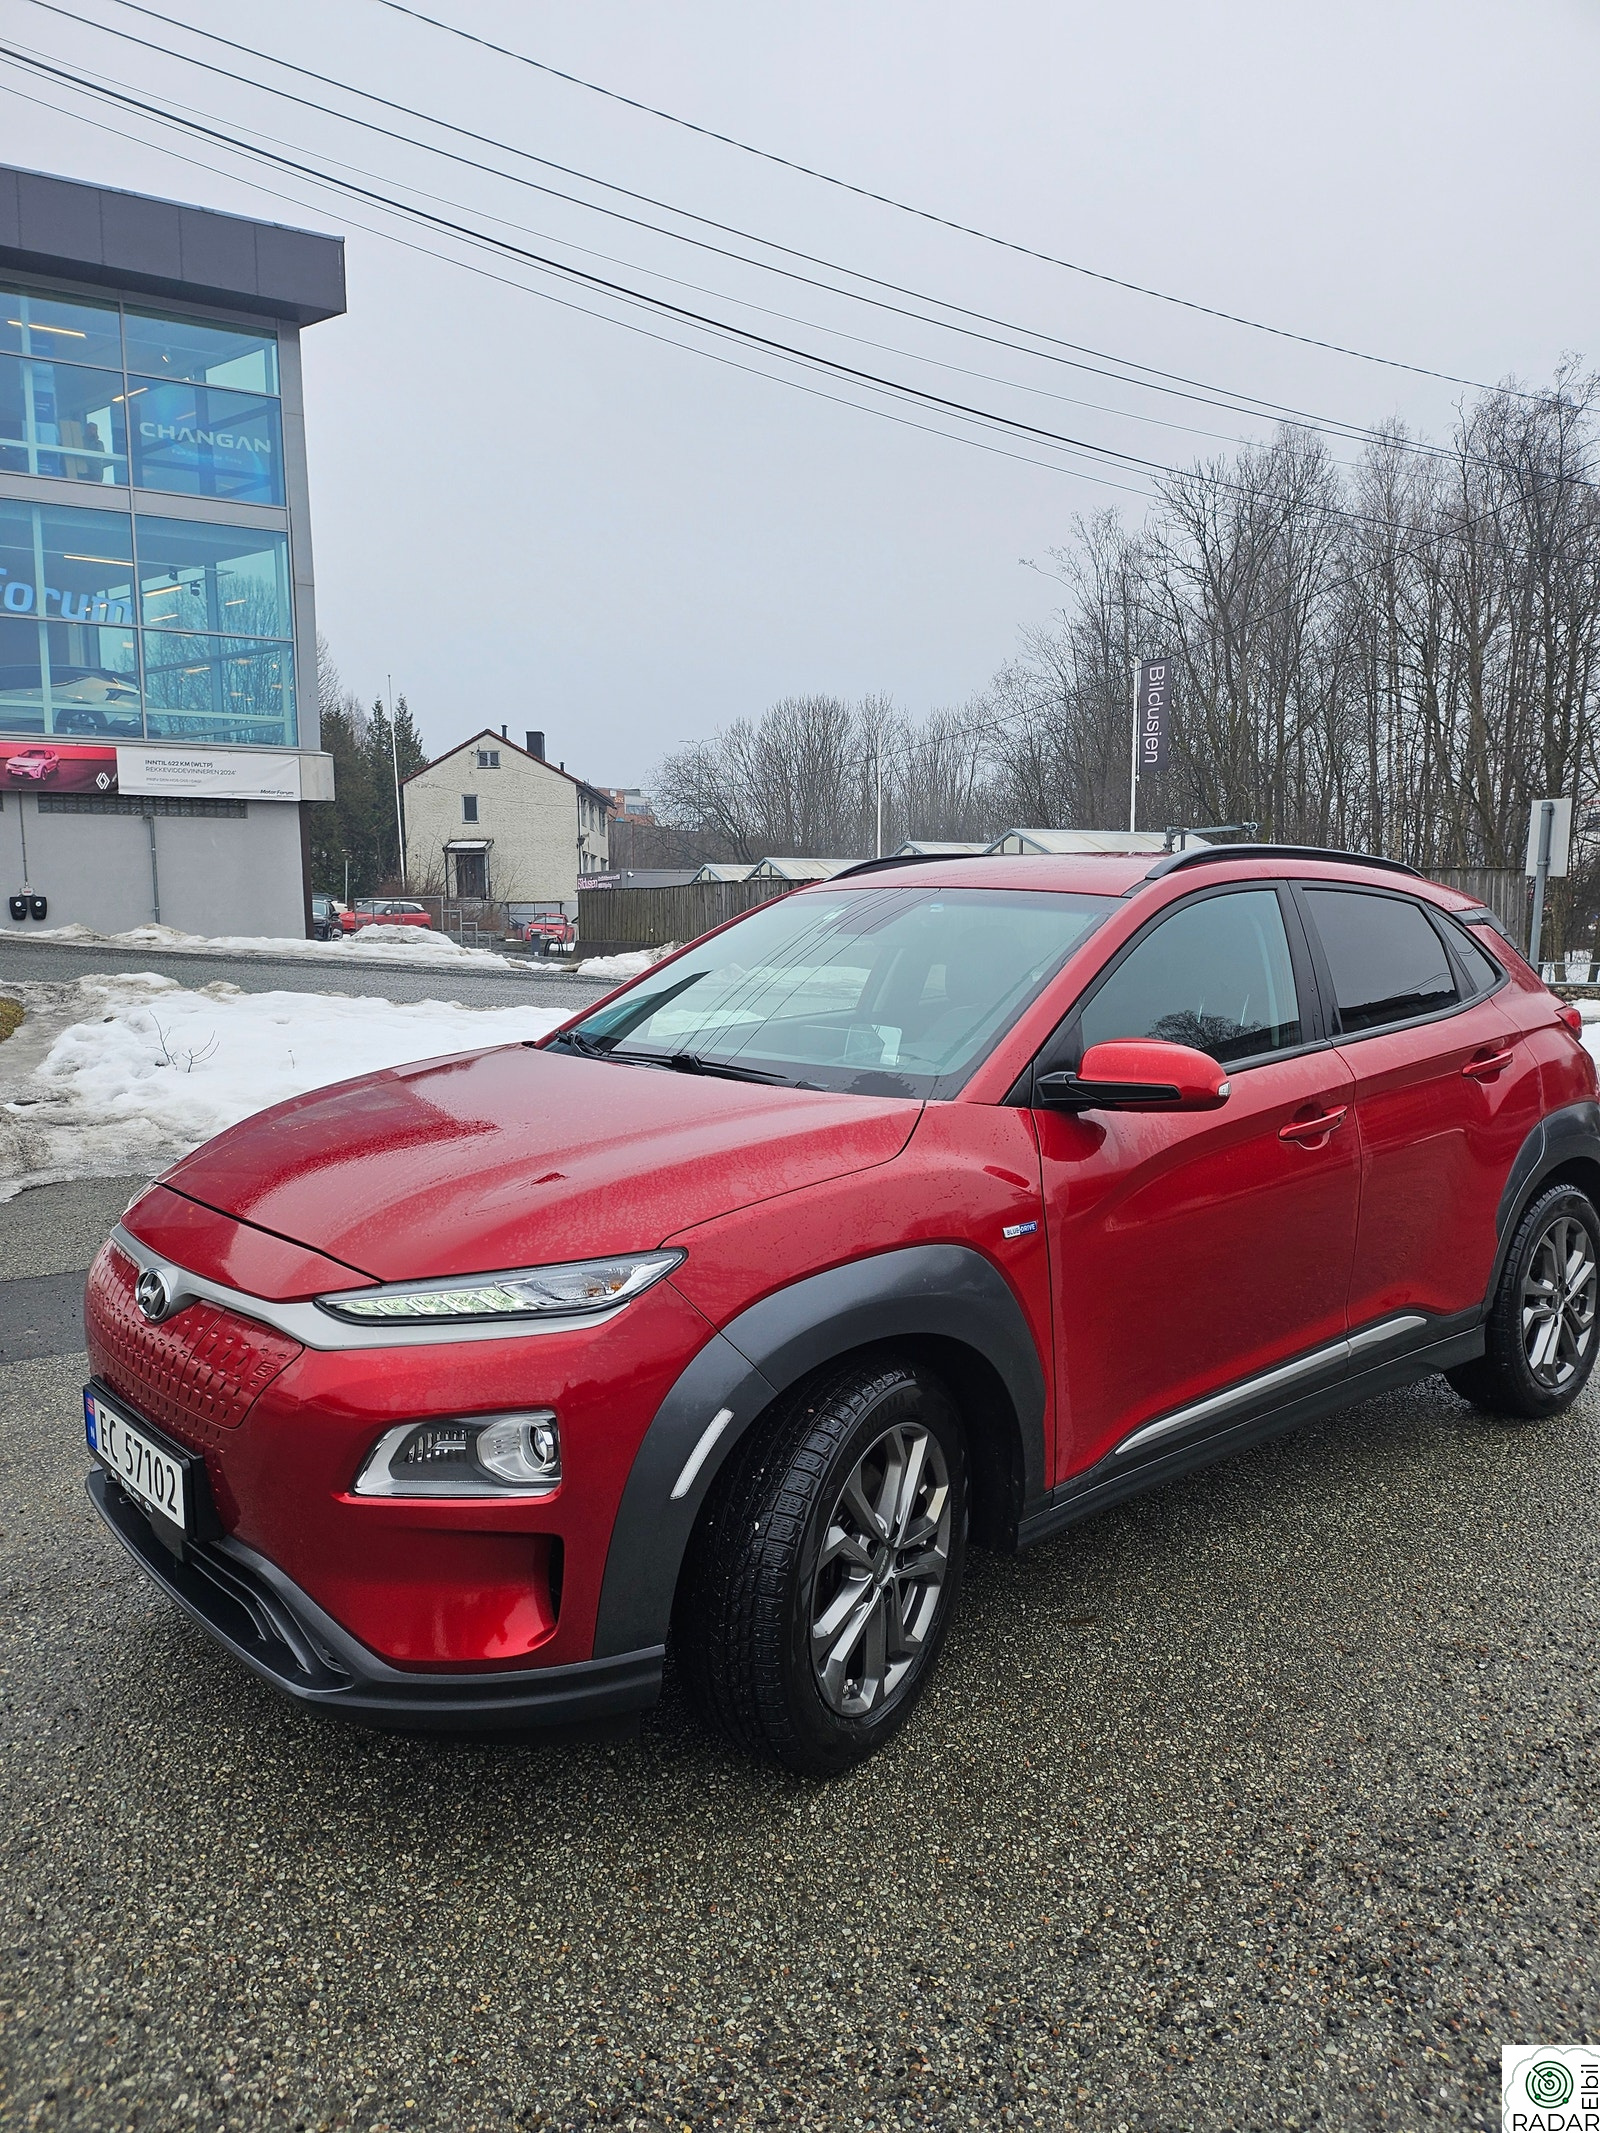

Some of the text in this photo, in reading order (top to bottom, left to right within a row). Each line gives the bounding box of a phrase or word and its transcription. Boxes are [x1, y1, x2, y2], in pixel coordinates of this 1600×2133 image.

[139, 422, 271, 453] CHANGAN
[0, 568, 133, 624] orum
[1142, 666, 1165, 763] Bildusjen
[100, 1409, 118, 1464] EC
[125, 1430, 178, 1516] 57102
